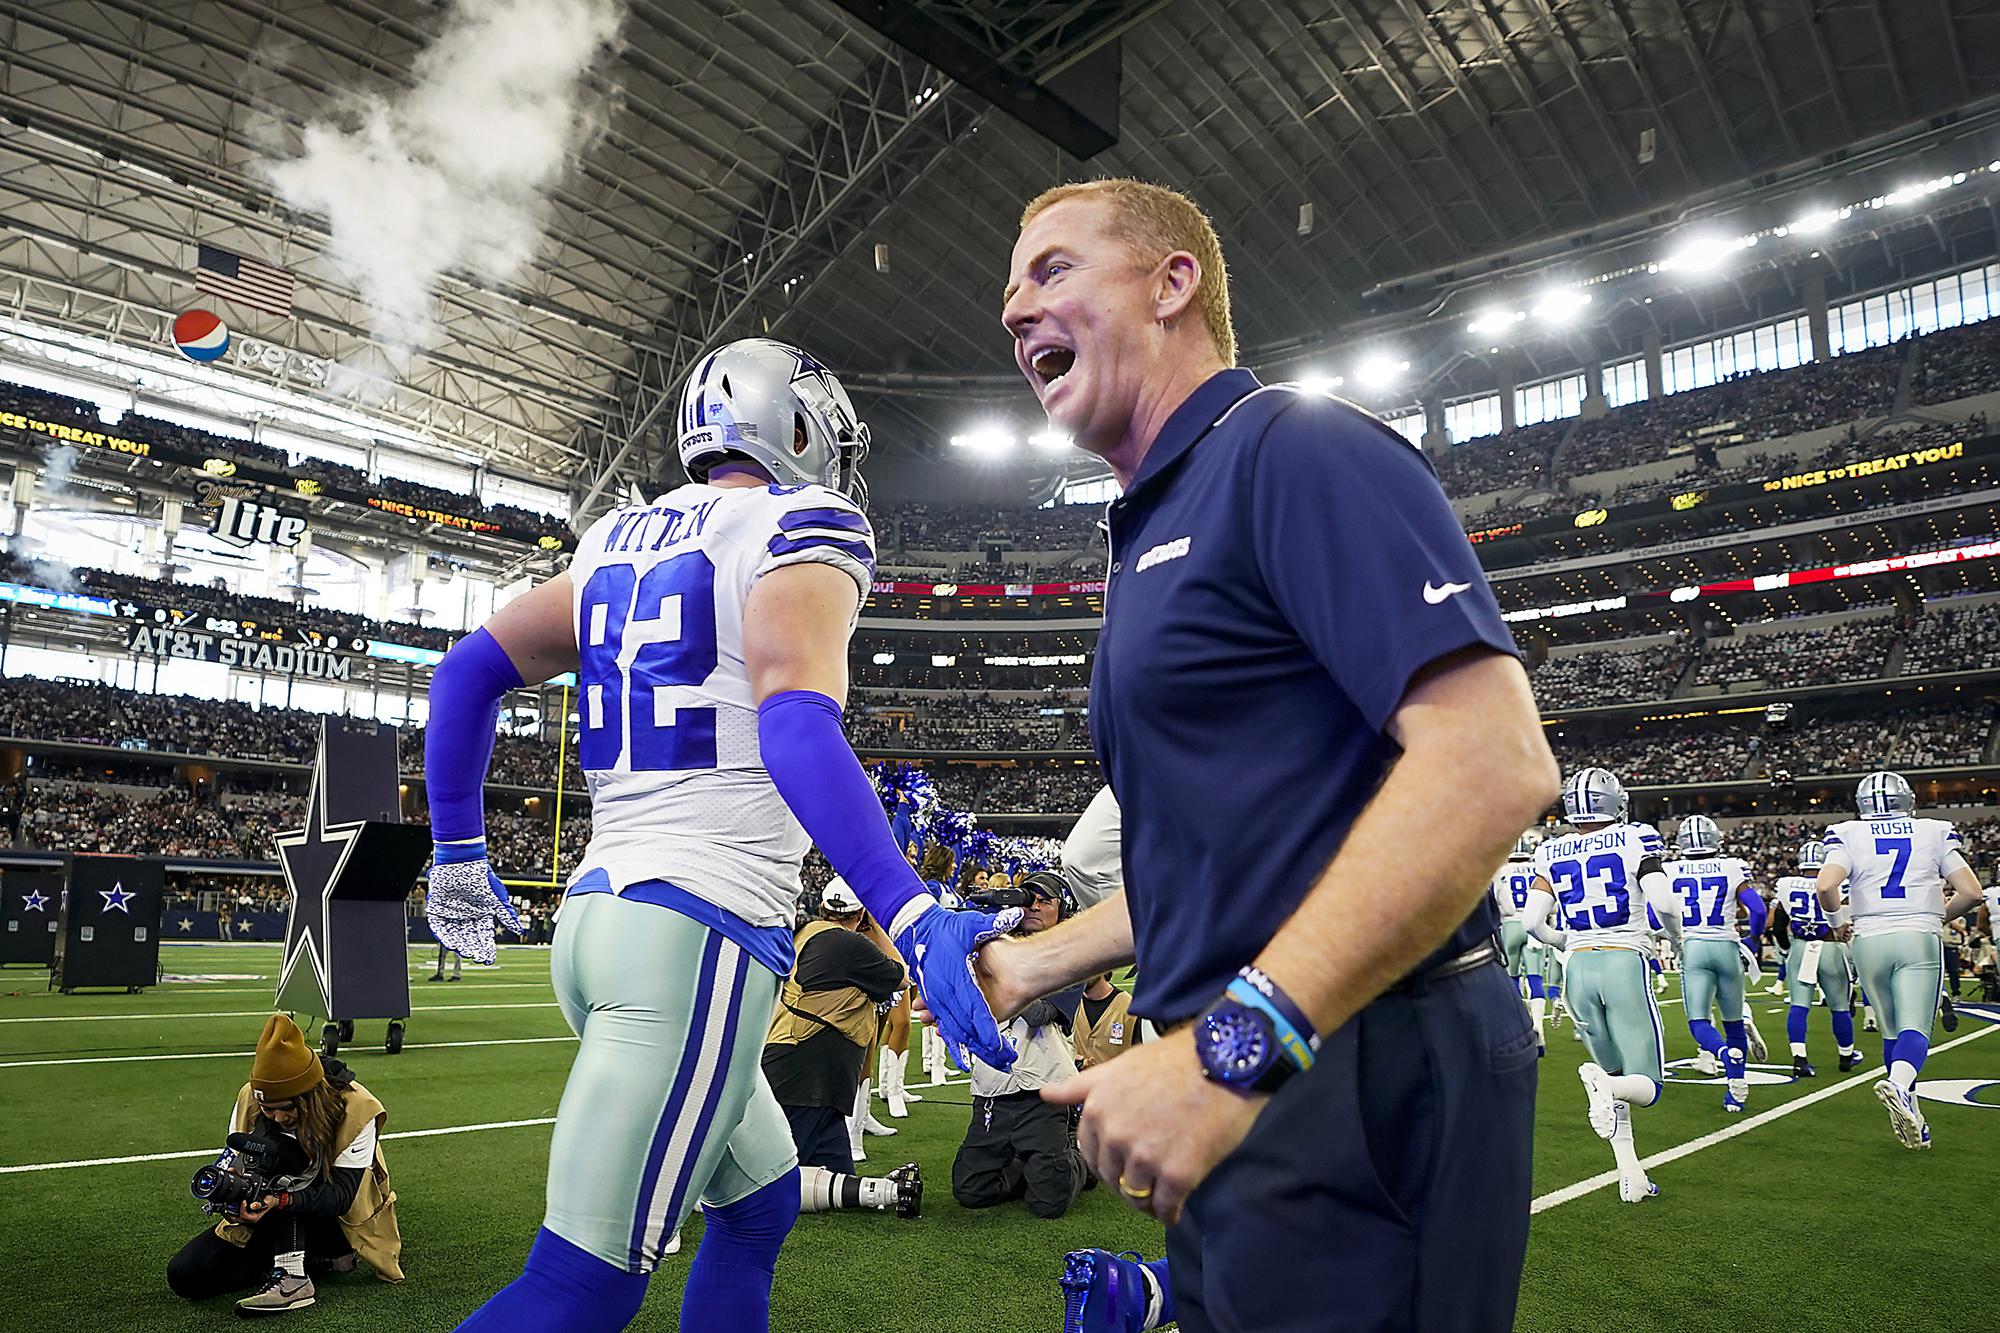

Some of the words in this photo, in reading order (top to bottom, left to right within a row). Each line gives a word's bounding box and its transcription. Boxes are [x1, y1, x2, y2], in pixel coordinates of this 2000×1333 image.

[0, 411, 28, 430] CE
[46, 421, 107, 447] TREAT
[107, 435, 151, 457] YOU!
[1782, 470, 1828, 491] NICE
[1844, 454, 1911, 478] TREAT
[1910, 442, 1964, 465] YOU!
[208, 494, 307, 548] Lite
[382, 499, 415, 518] NICE
[426, 509, 470, 530] TREAT
[604, 496, 723, 553] WITTEN
[871, 581, 894, 594] OU!
[129, 625, 214, 661] AT&T
[218, 637, 352, 683] STADIUM
[578, 548, 719, 772] 82
[1544, 831, 1627, 861] THOMPSON
[1869, 821, 1915, 836] RUSH
[1509, 875, 1536, 909] 8
[1548, 852, 1631, 932] 23
[1677, 862, 1722, 875] WILSON
[1874, 837, 1913, 899] 7
[1672, 875, 1729, 927] 37
